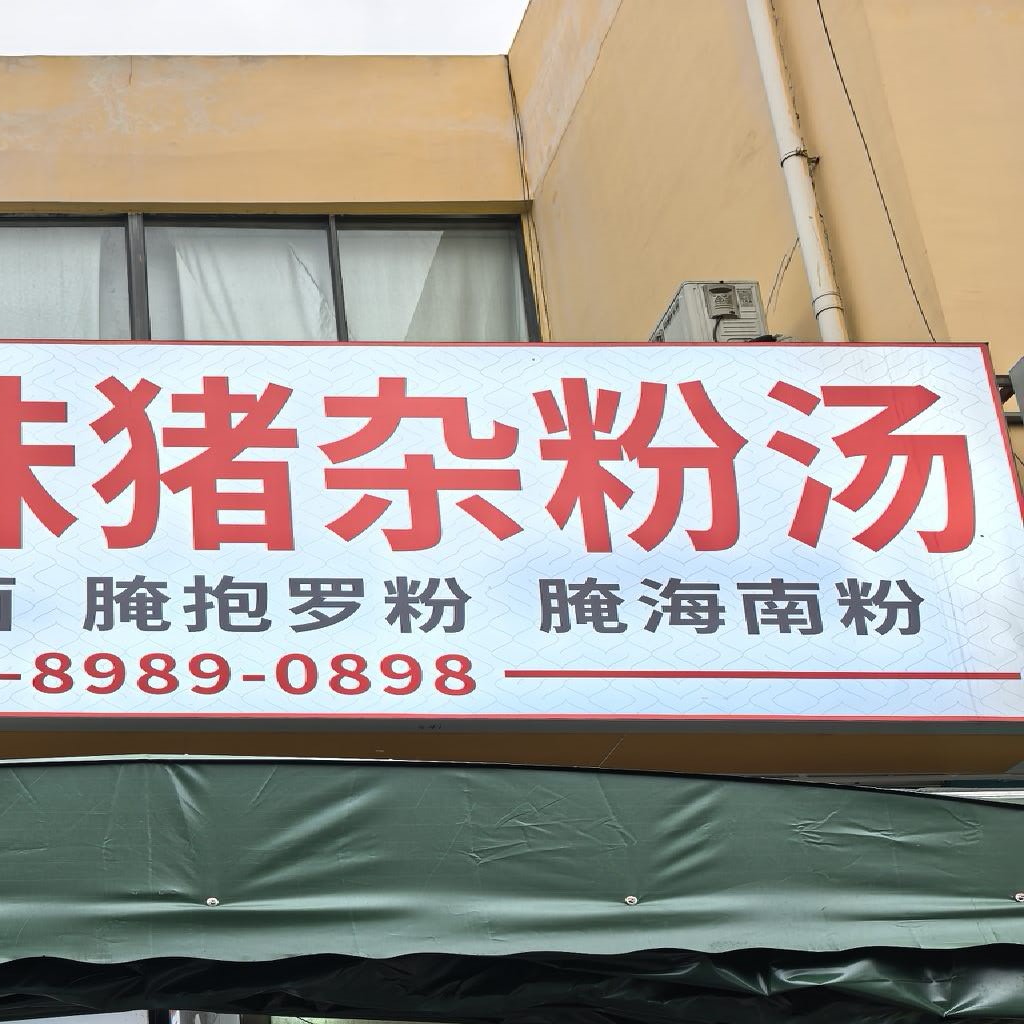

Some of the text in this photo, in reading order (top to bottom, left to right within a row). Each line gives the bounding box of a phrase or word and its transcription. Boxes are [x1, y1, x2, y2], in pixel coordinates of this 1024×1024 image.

[82, 574, 472, 634] 腌抱罗粉
[538, 577, 925, 636] 腌海南粉
